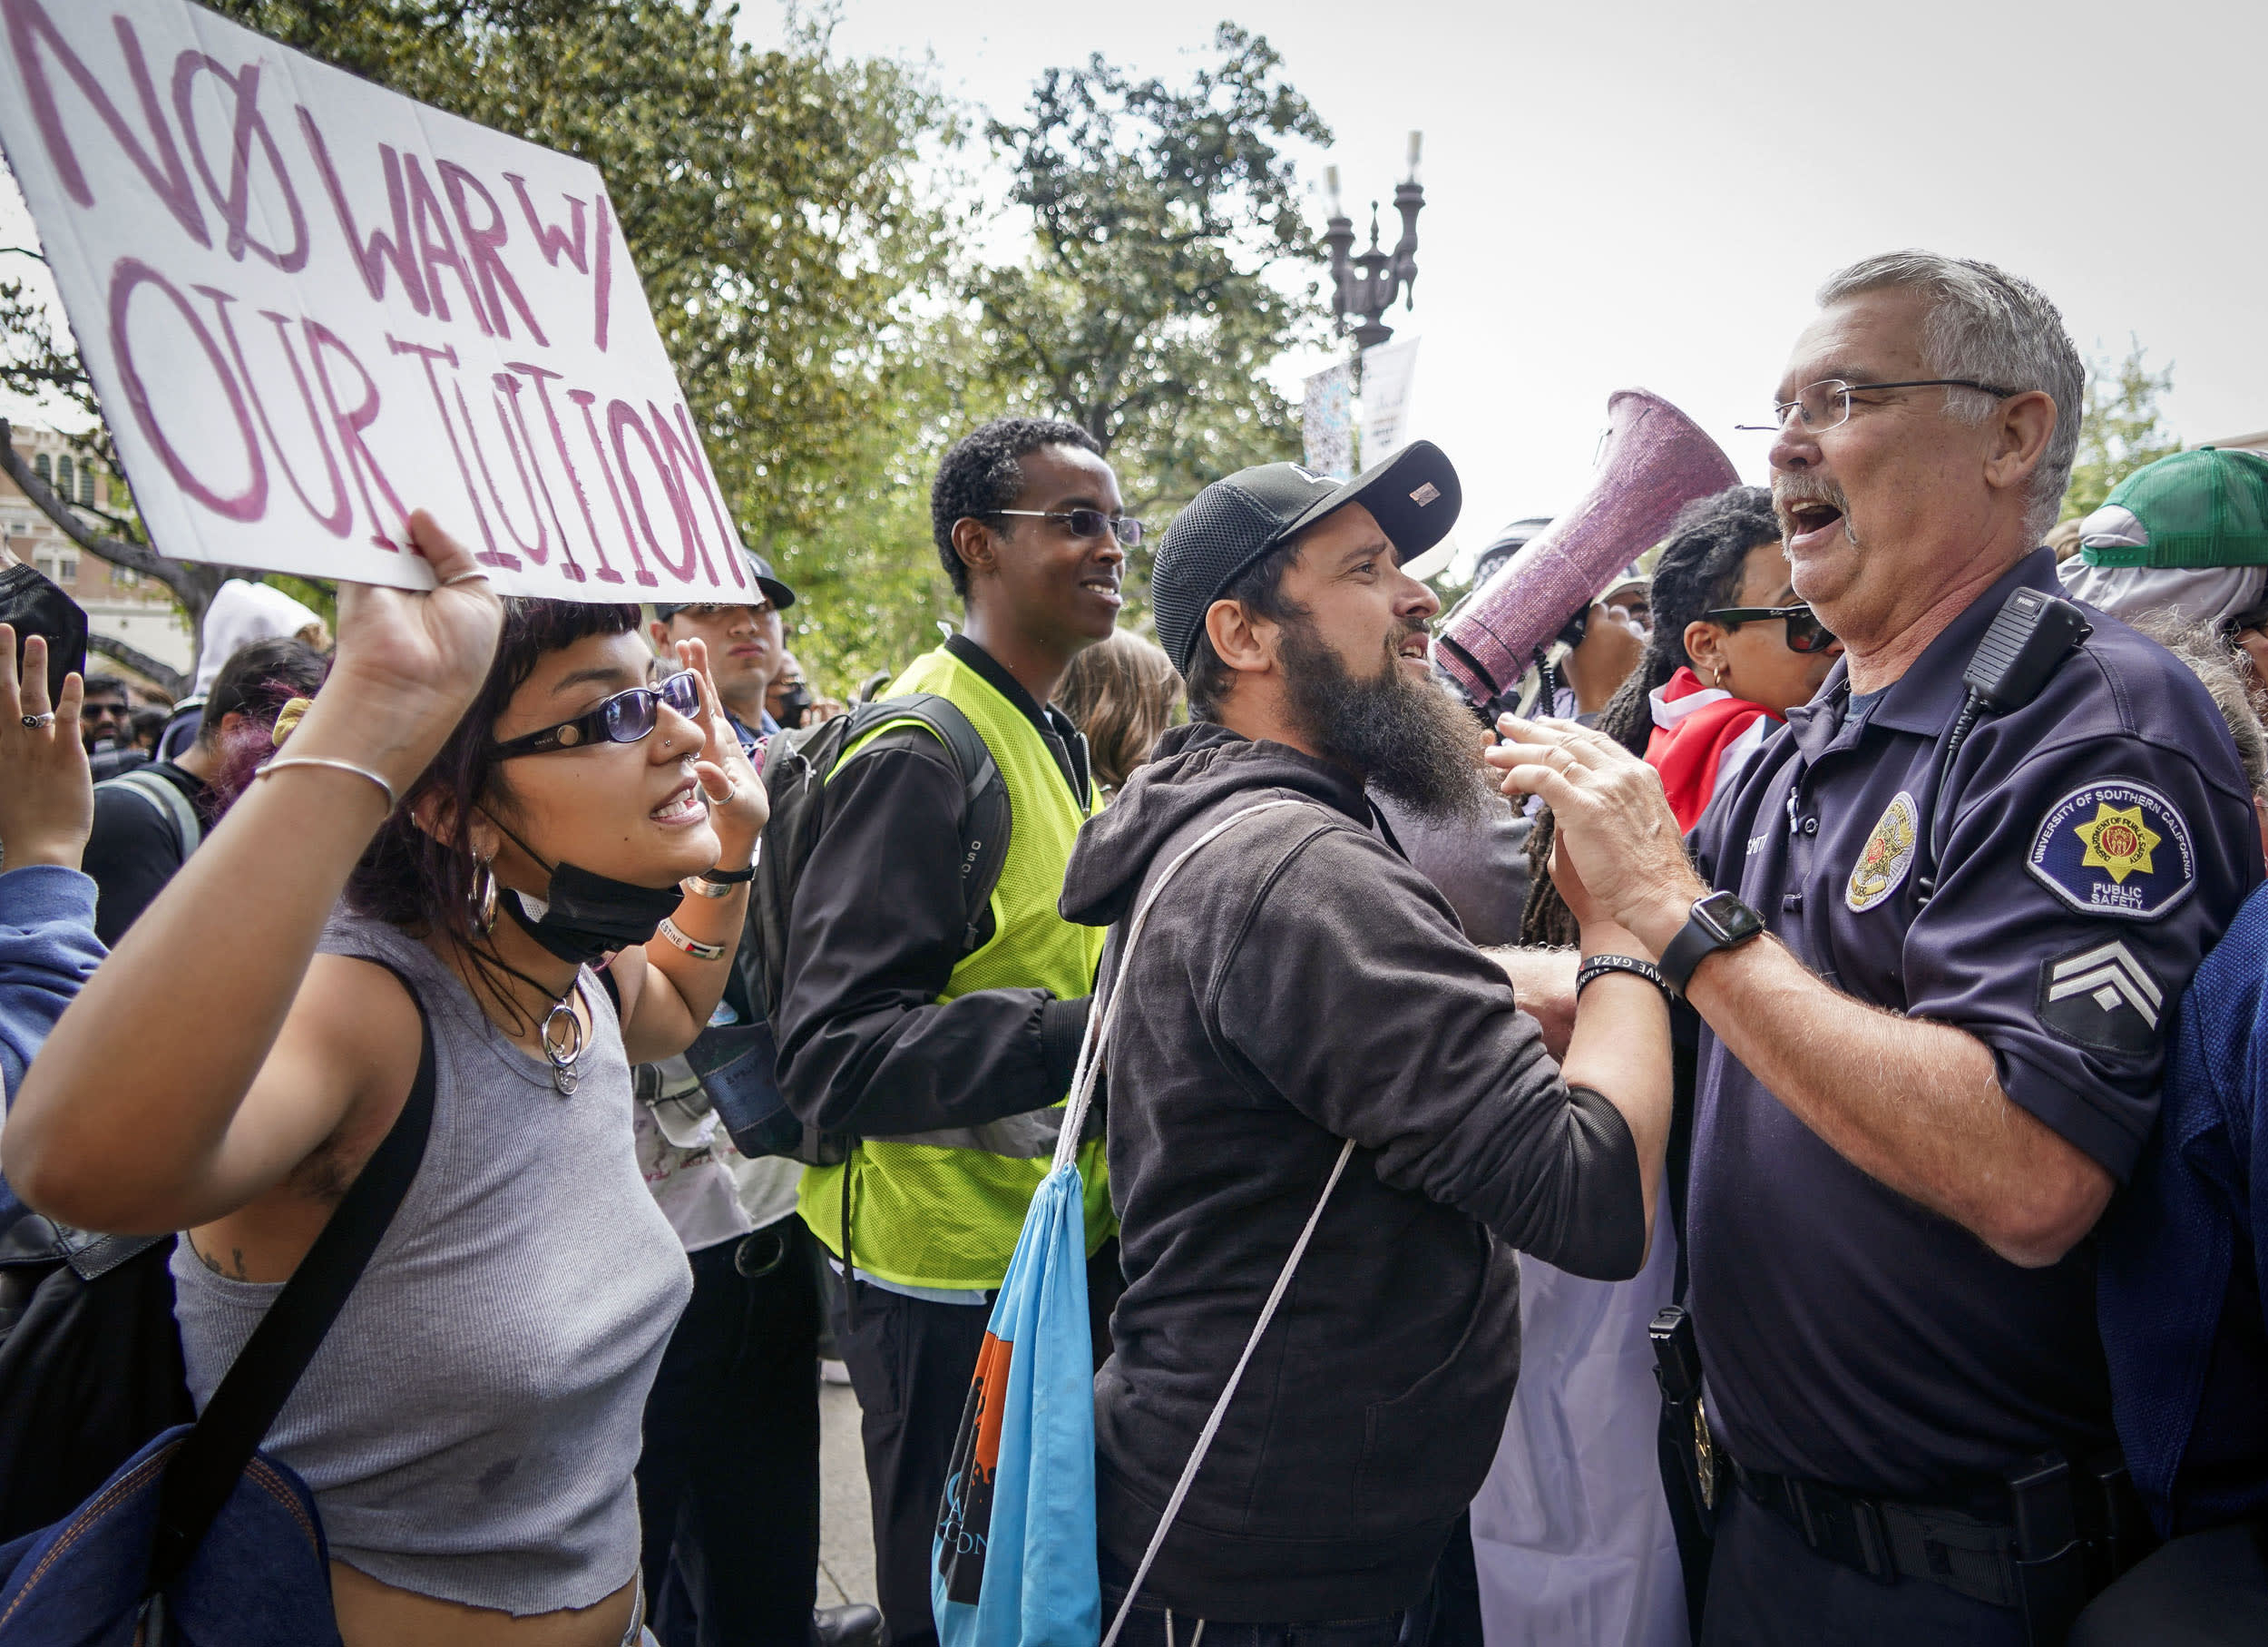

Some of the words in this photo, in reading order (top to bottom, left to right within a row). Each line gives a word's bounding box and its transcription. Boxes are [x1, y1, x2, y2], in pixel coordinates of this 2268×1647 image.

[294, 103, 550, 348] WAR
[501, 172, 611, 353] W/
[108, 256, 426, 558] OUR
[2111, 817, 2122, 825] OF
[2122, 818, 2145, 840] PUBLIC
[2033, 803, 2076, 863] UNIVERSITY
[2076, 793, 2093, 808] OF
[2095, 789, 2162, 814] SOUTHERN
[2161, 812, 2192, 879] CALIFORNIA
[2092, 819, 2111, 861] DEPARTMENT
[2129, 842, 2146, 865] SAFETY
[2090, 893, 2143, 909] SAFETY
[2093, 883, 2142, 897] PUBLIC
[660, 921, 682, 946] ESTINE
[1593, 956, 1633, 967] GAZA
